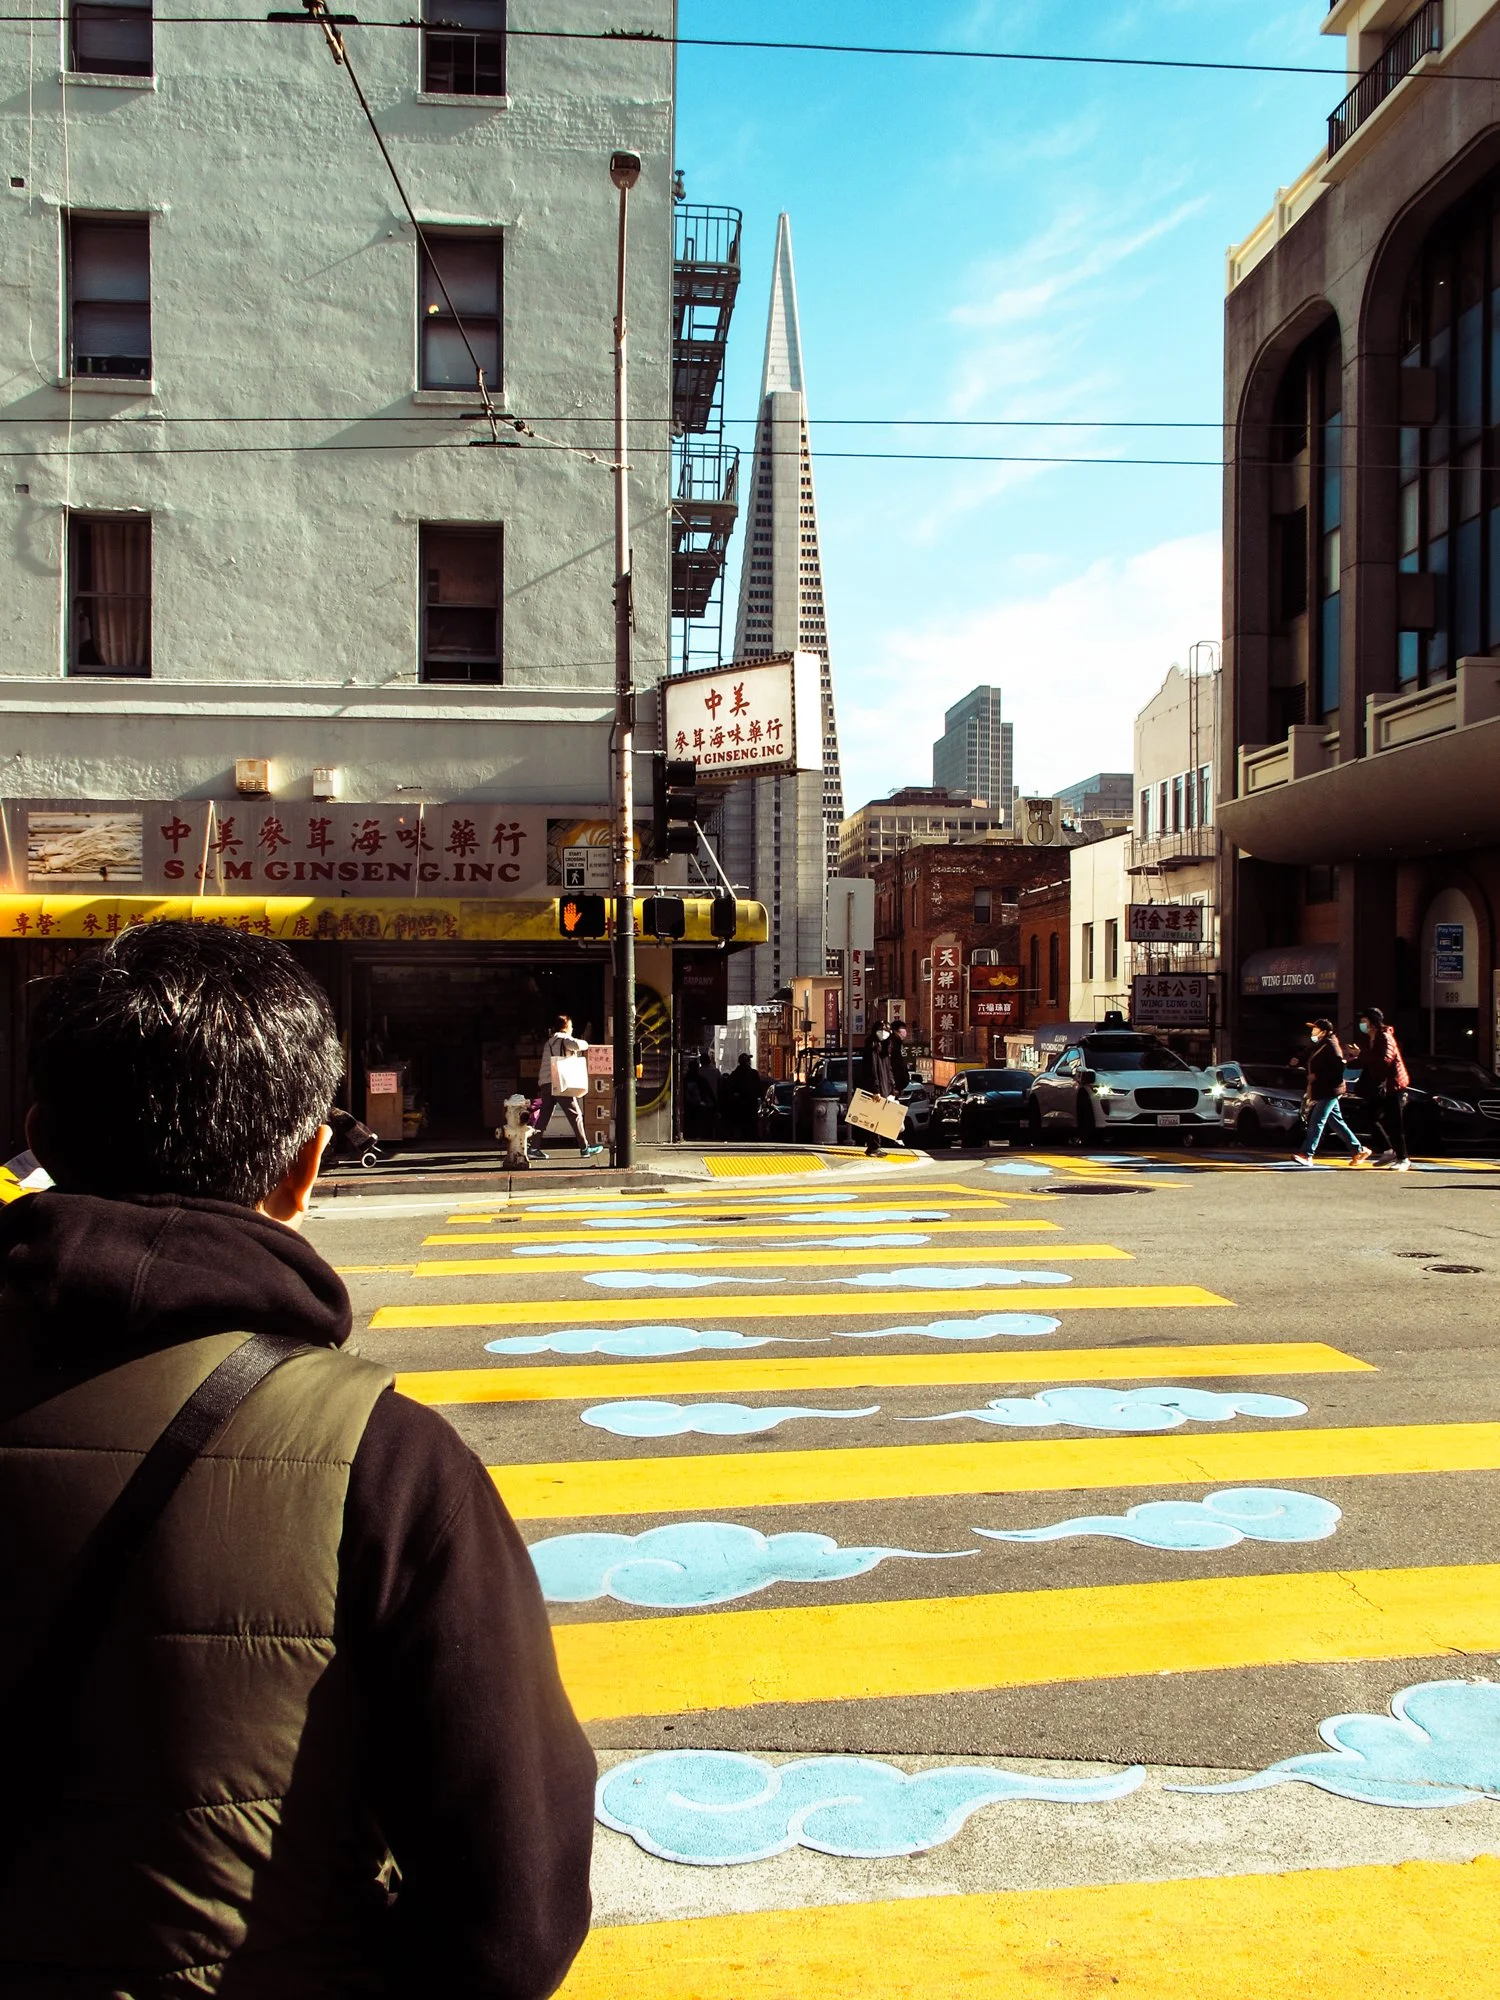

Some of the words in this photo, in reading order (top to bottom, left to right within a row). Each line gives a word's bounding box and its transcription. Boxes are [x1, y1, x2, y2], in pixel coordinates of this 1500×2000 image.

[704, 682, 750, 720] 中美
[164, 861, 184, 880] S
[223, 861, 253, 880] M
[1261, 976, 1280, 987] WING
[1282, 975, 1302, 986] LUNG
[1140, 1000, 1163, 1008] WING
